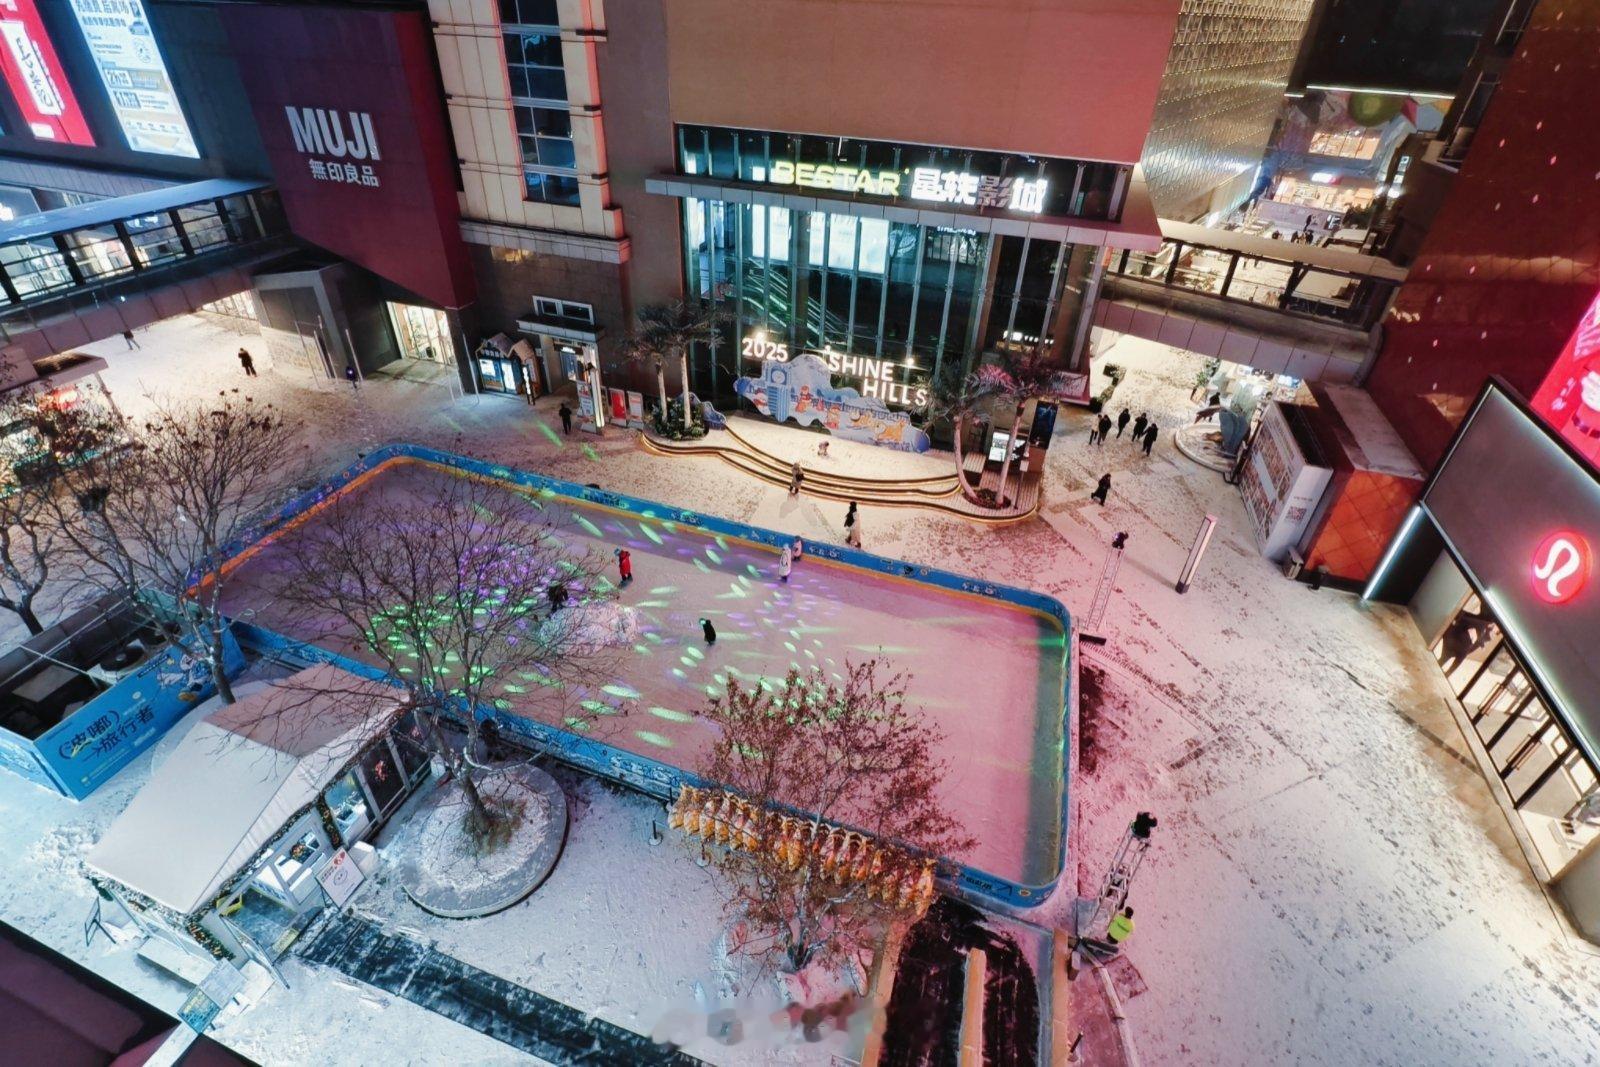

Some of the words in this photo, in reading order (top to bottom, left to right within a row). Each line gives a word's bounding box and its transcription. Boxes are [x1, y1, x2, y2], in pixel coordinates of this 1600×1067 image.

[285, 106, 380, 160] MUJI
[309, 159, 379, 187] 無印良品
[774, 160, 900, 196] BESTAR
[742, 337, 789, 362] 2025
[828, 351, 895, 382] SHINE
[862, 377, 928, 407] HILLS
[100, 705, 155, 753] 旅行者
